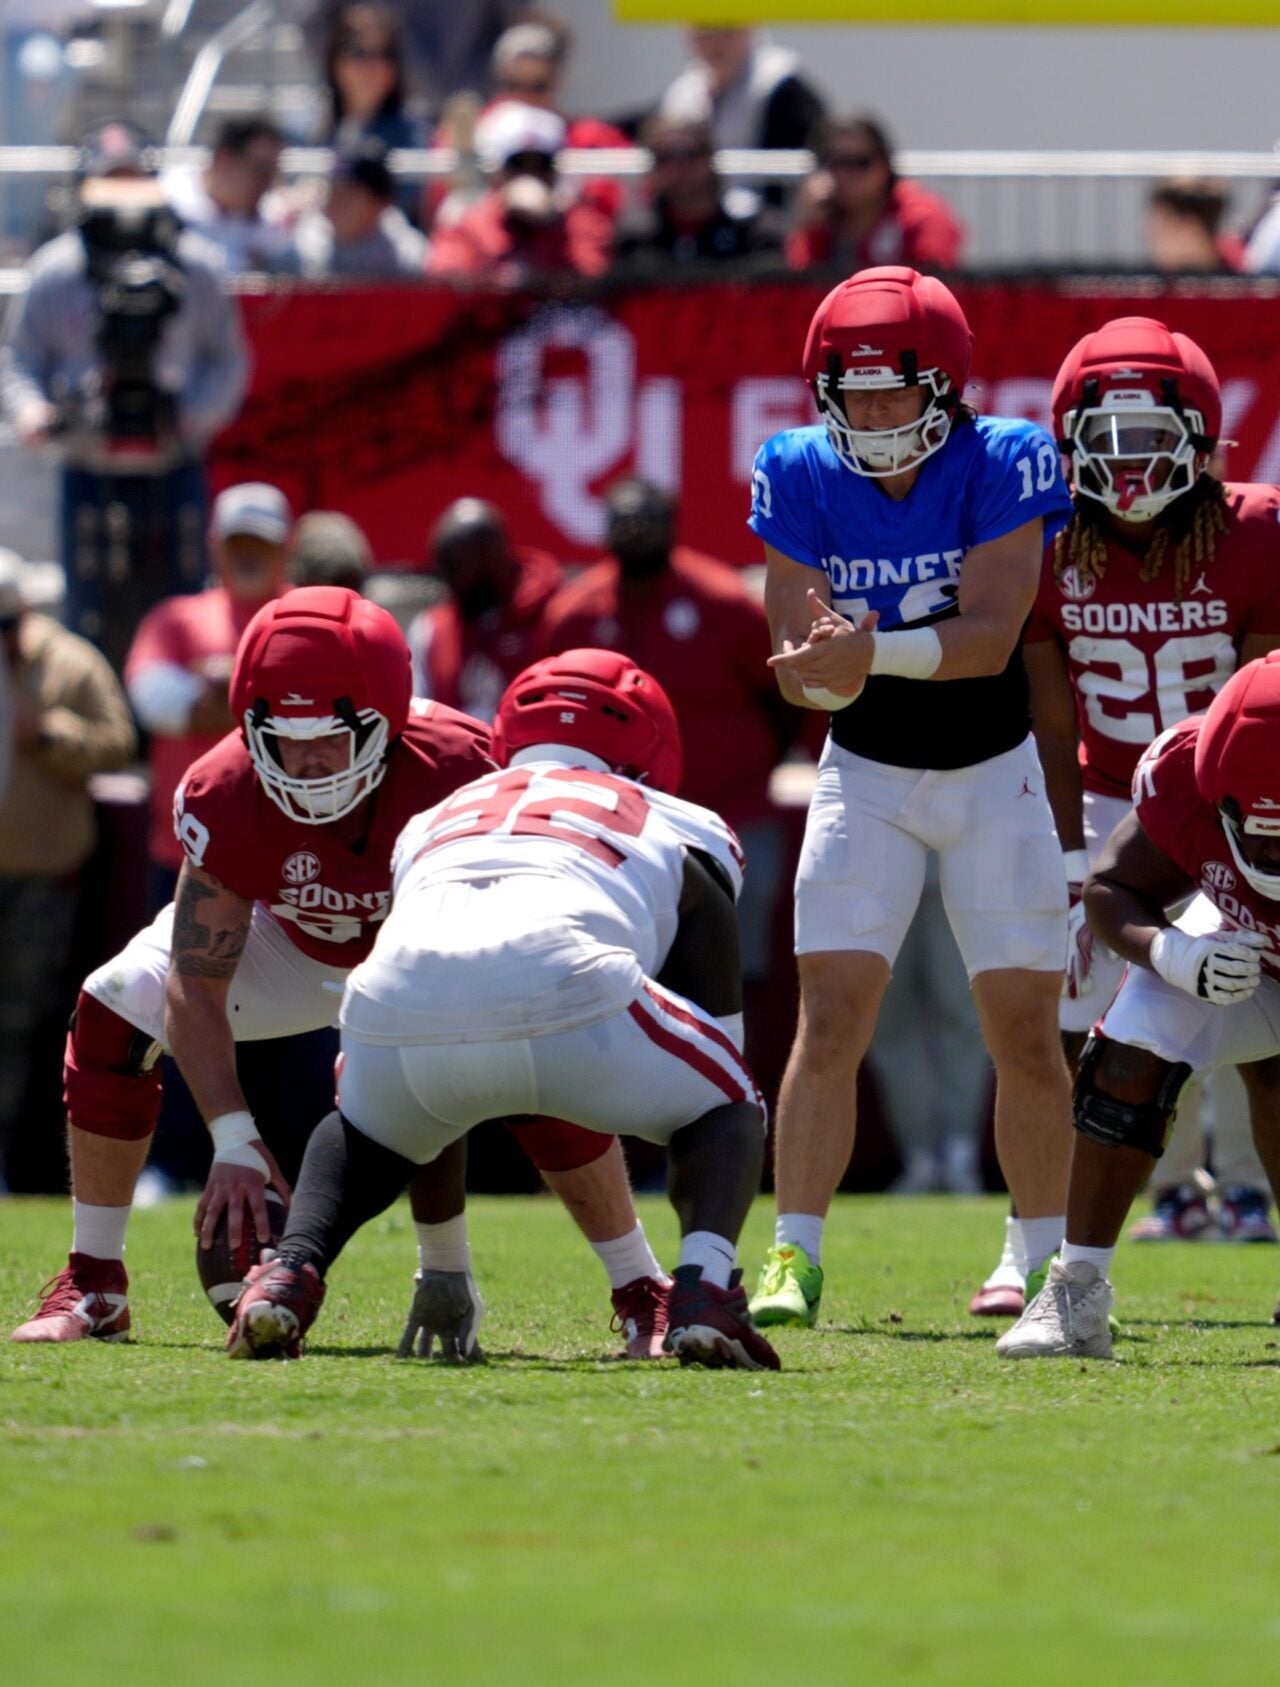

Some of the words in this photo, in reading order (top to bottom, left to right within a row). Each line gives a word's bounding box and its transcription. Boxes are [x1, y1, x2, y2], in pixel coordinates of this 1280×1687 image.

[1016, 445, 1056, 501] 10
[1061, 600, 1229, 634] SOONERS
[284, 854, 319, 882] SEC
[1203, 863, 1235, 890] SEC
